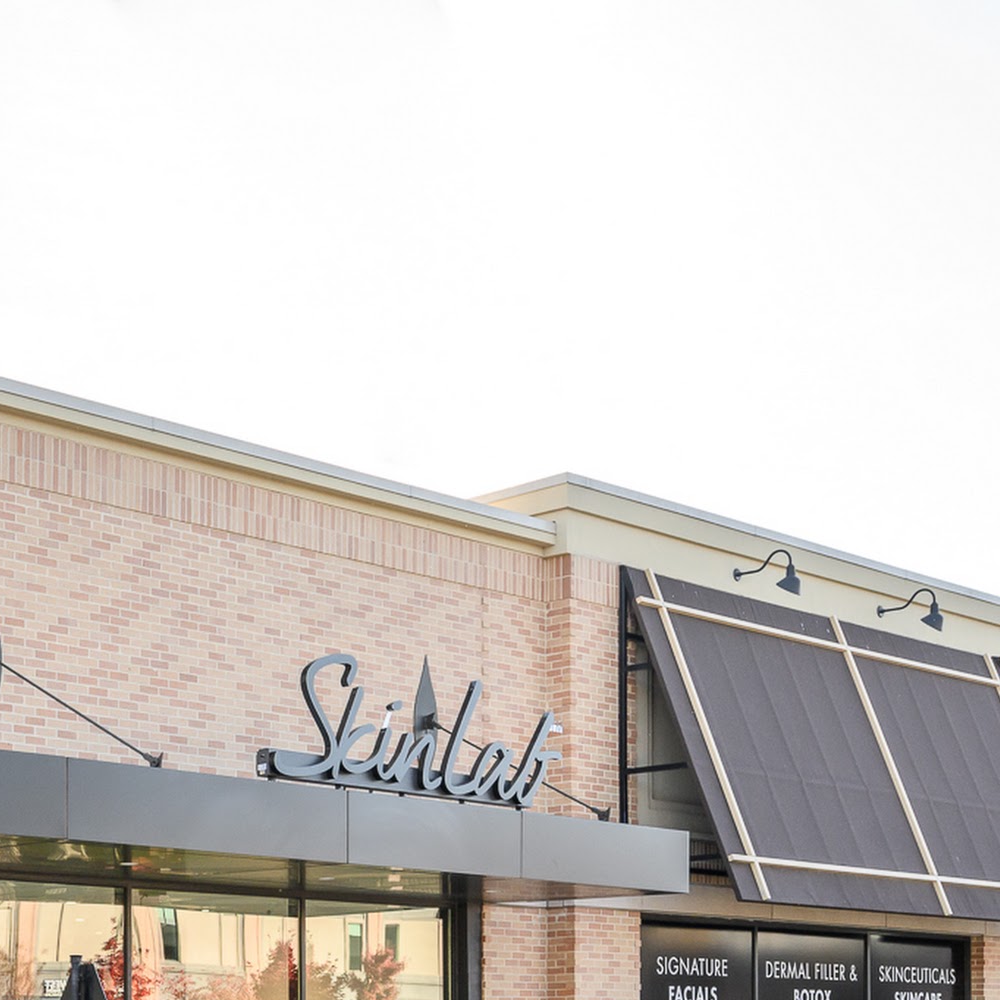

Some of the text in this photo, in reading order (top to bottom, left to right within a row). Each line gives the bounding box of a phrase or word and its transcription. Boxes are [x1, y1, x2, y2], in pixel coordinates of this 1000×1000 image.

[272, 652, 563, 807] SkinLab
[656, 956, 728, 977] SIGNATURE
[765, 960, 858, 982] DERMAL FILLER &
[878, 965, 956, 985] SKINCEUTICALS
